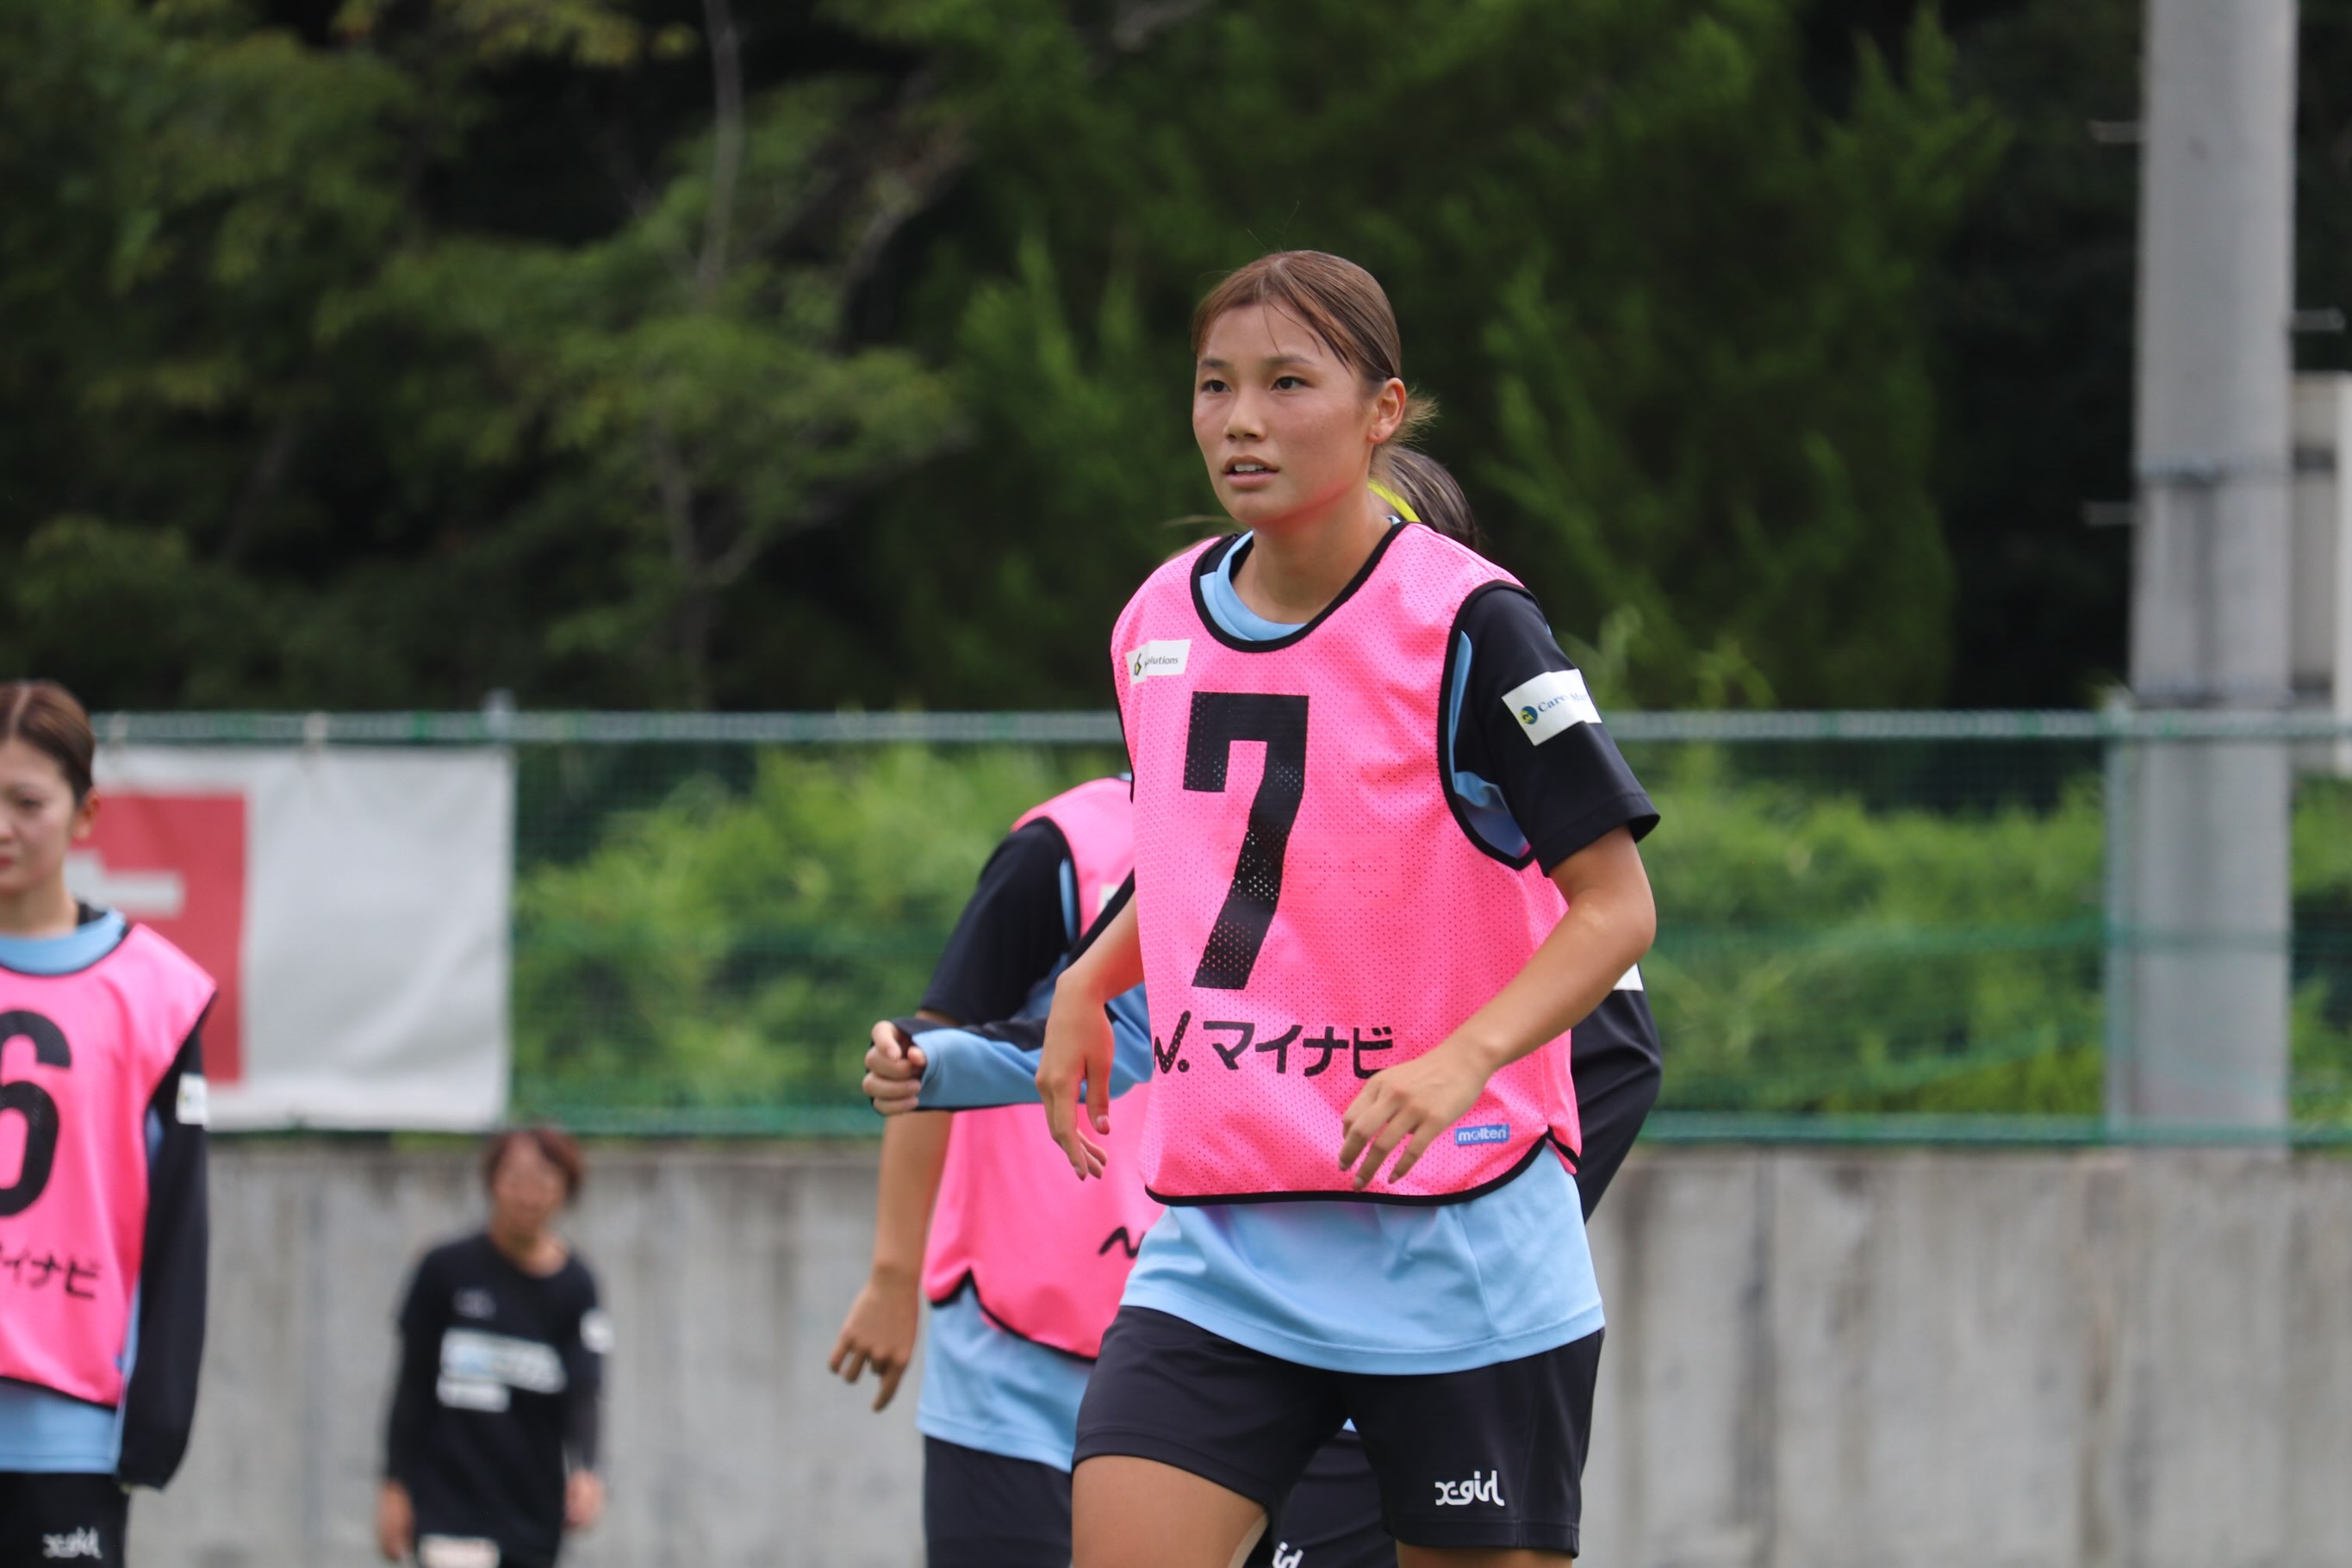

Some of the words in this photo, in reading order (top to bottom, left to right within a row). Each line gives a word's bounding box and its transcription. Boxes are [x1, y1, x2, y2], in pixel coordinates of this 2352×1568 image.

[1183, 691, 1309, 990] 7
[1458, 1128, 1507, 1142] molten
[0, 1242, 100, 1300] イナビ
